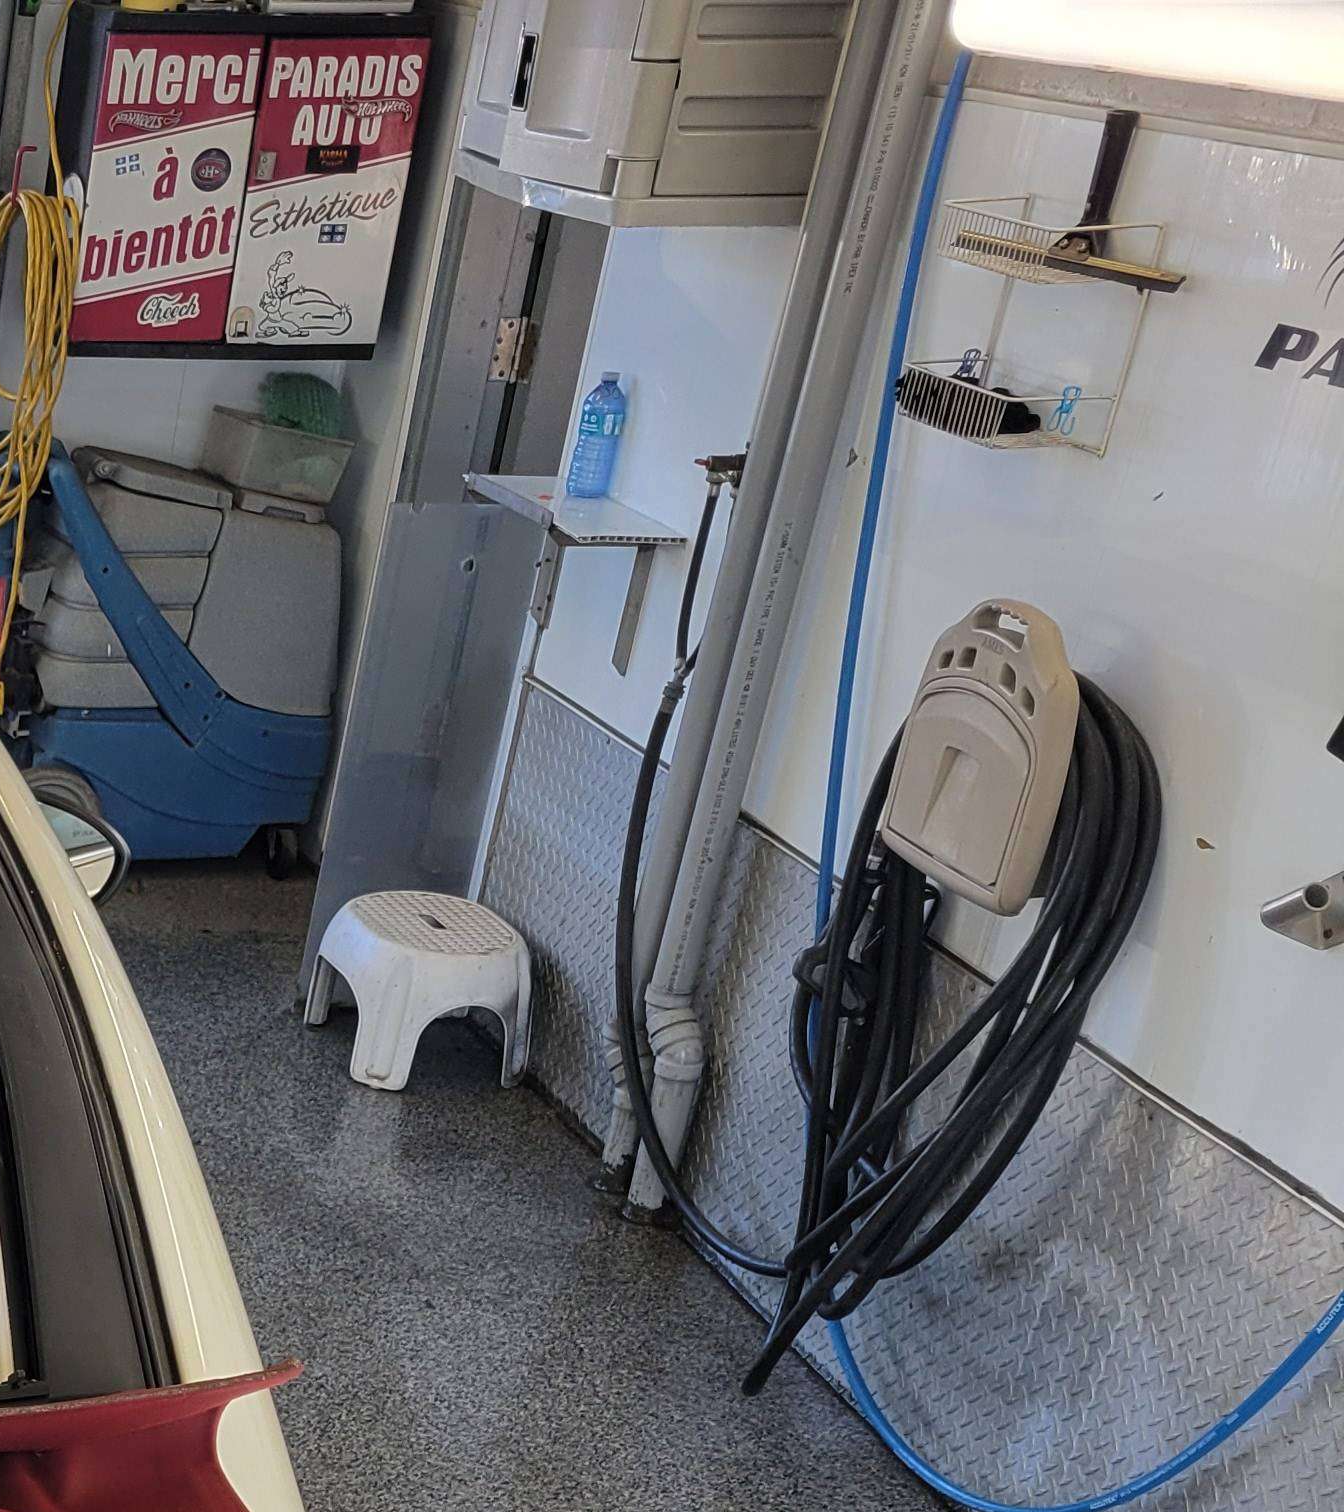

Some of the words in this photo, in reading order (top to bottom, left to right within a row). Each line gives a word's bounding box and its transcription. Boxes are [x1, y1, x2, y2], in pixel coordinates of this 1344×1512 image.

[107, 48, 261, 105] Merci
[269, 54, 423, 99] PARADIS
[153, 147, 179, 201] à
[249, 187, 398, 239] Esthétique
[81, 206, 236, 283] bientôt
[1254, 323, 1344, 388] PA
